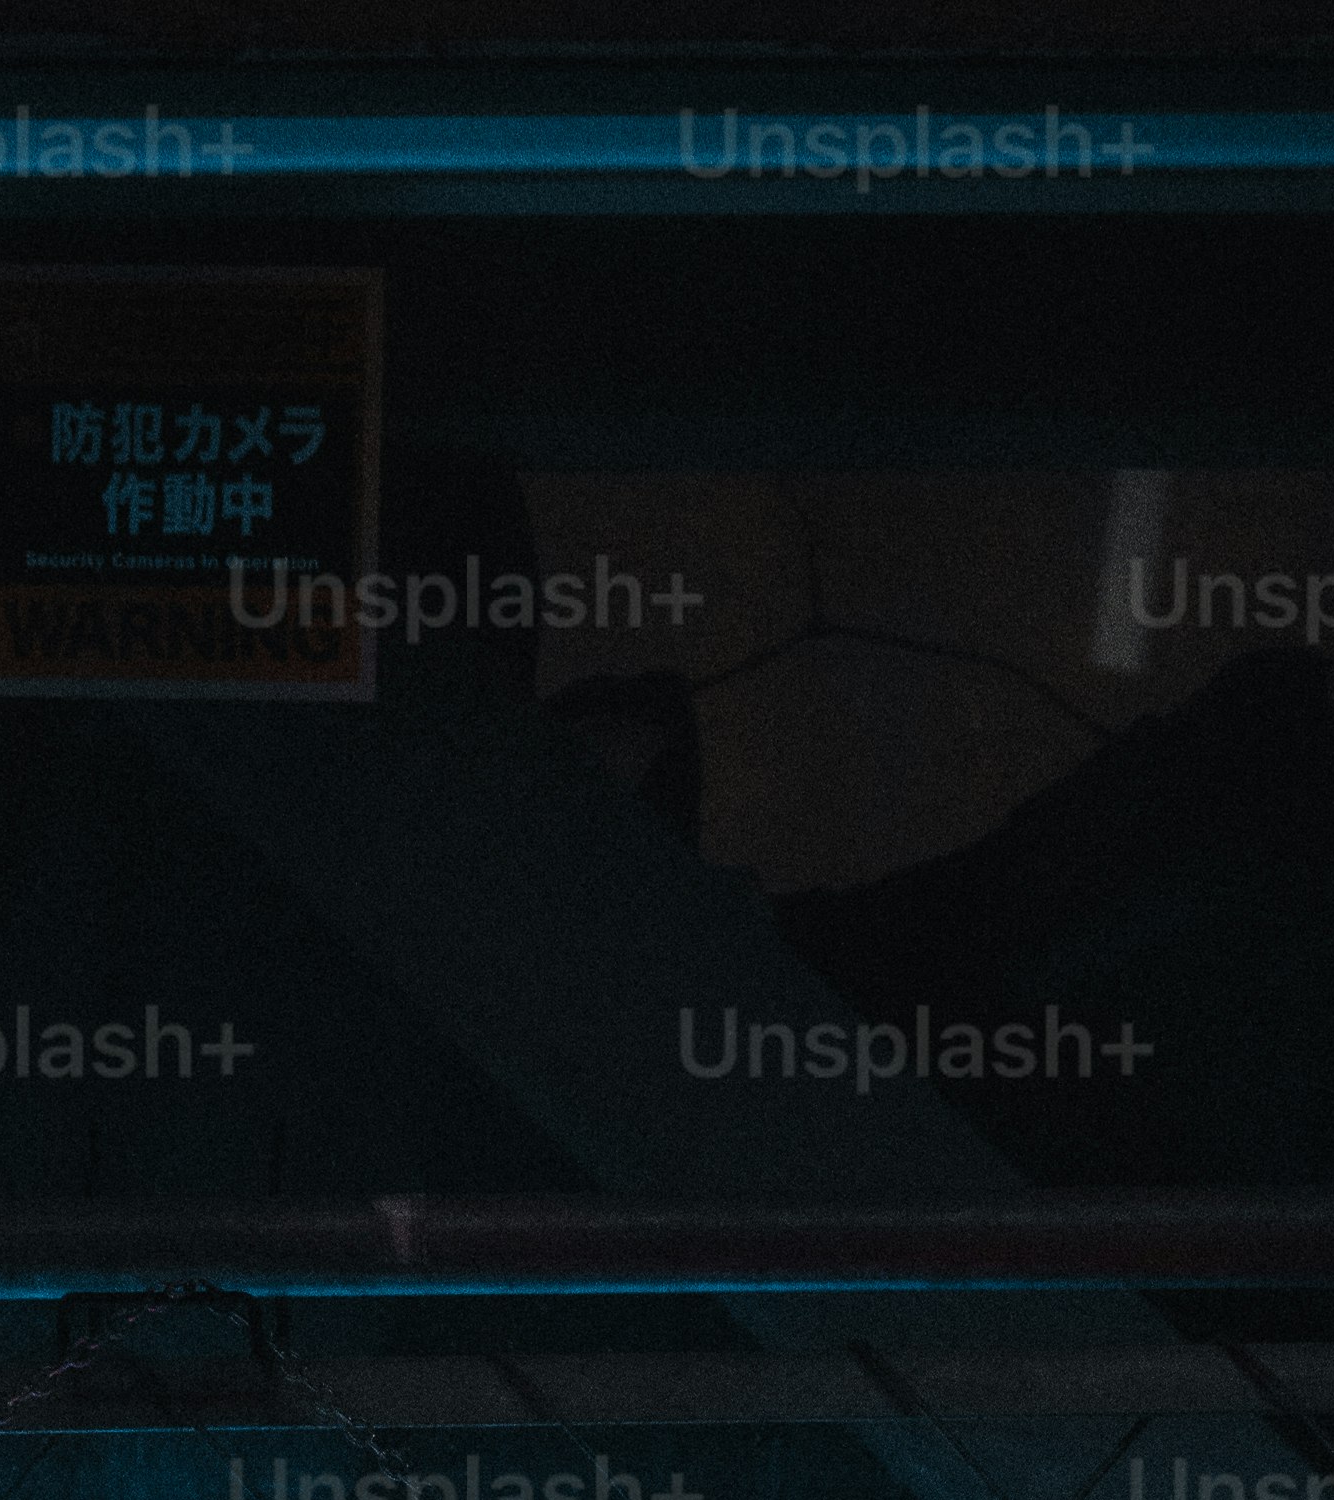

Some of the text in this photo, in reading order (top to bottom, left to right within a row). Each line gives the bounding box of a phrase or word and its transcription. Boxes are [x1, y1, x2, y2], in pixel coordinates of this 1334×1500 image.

[51, 400, 327, 468] 防犯カメラ
[101, 470, 275, 537] 作動中
[5, 599, 342, 662] WARNING
